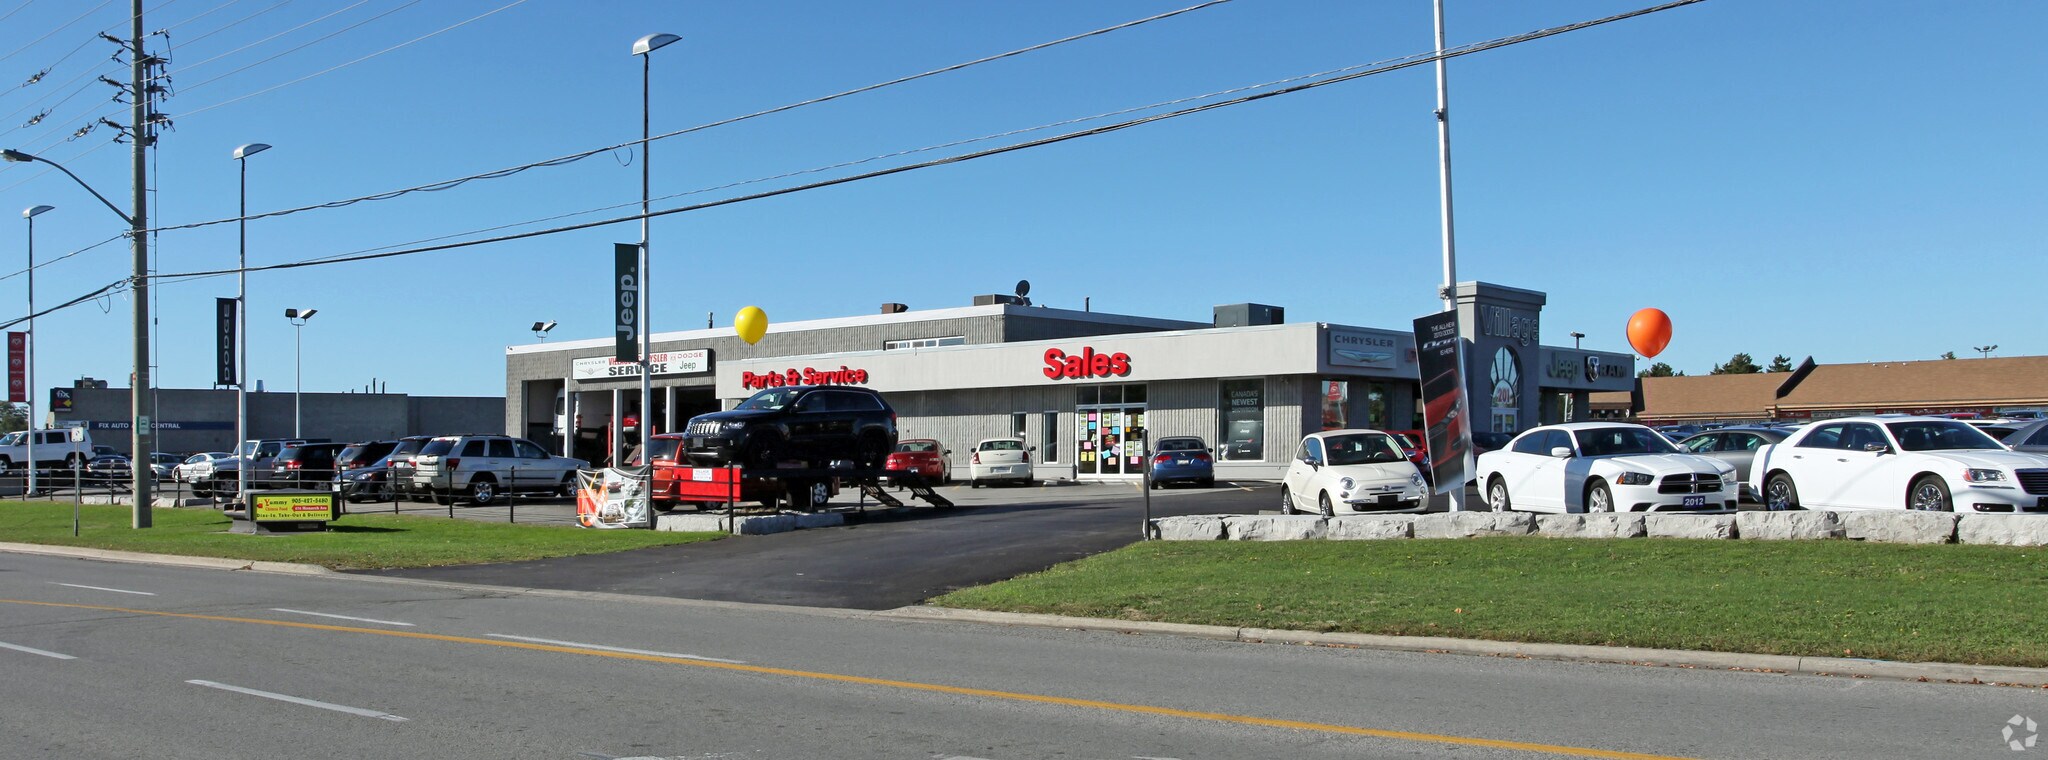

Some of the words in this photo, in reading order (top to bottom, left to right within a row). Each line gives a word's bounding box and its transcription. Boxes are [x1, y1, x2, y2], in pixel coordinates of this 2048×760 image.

[1480, 304, 1540, 347] Village
[1334, 334, 1395, 348] CHRYSLER
[575, 359, 606, 367] CHRYSLER
[608, 363, 668, 376] SERVCE
[679, 360, 697, 370] Jeep
[1042, 346, 1132, 380] Sales
[1546, 352, 1580, 384] Jeep
[742, 370, 786, 390] Parts
[786, 368, 801, 386] &
[802, 365, 868, 385] Service
[1600, 364, 1627, 378] RAM
[1684, 497, 1704, 506] 2012
